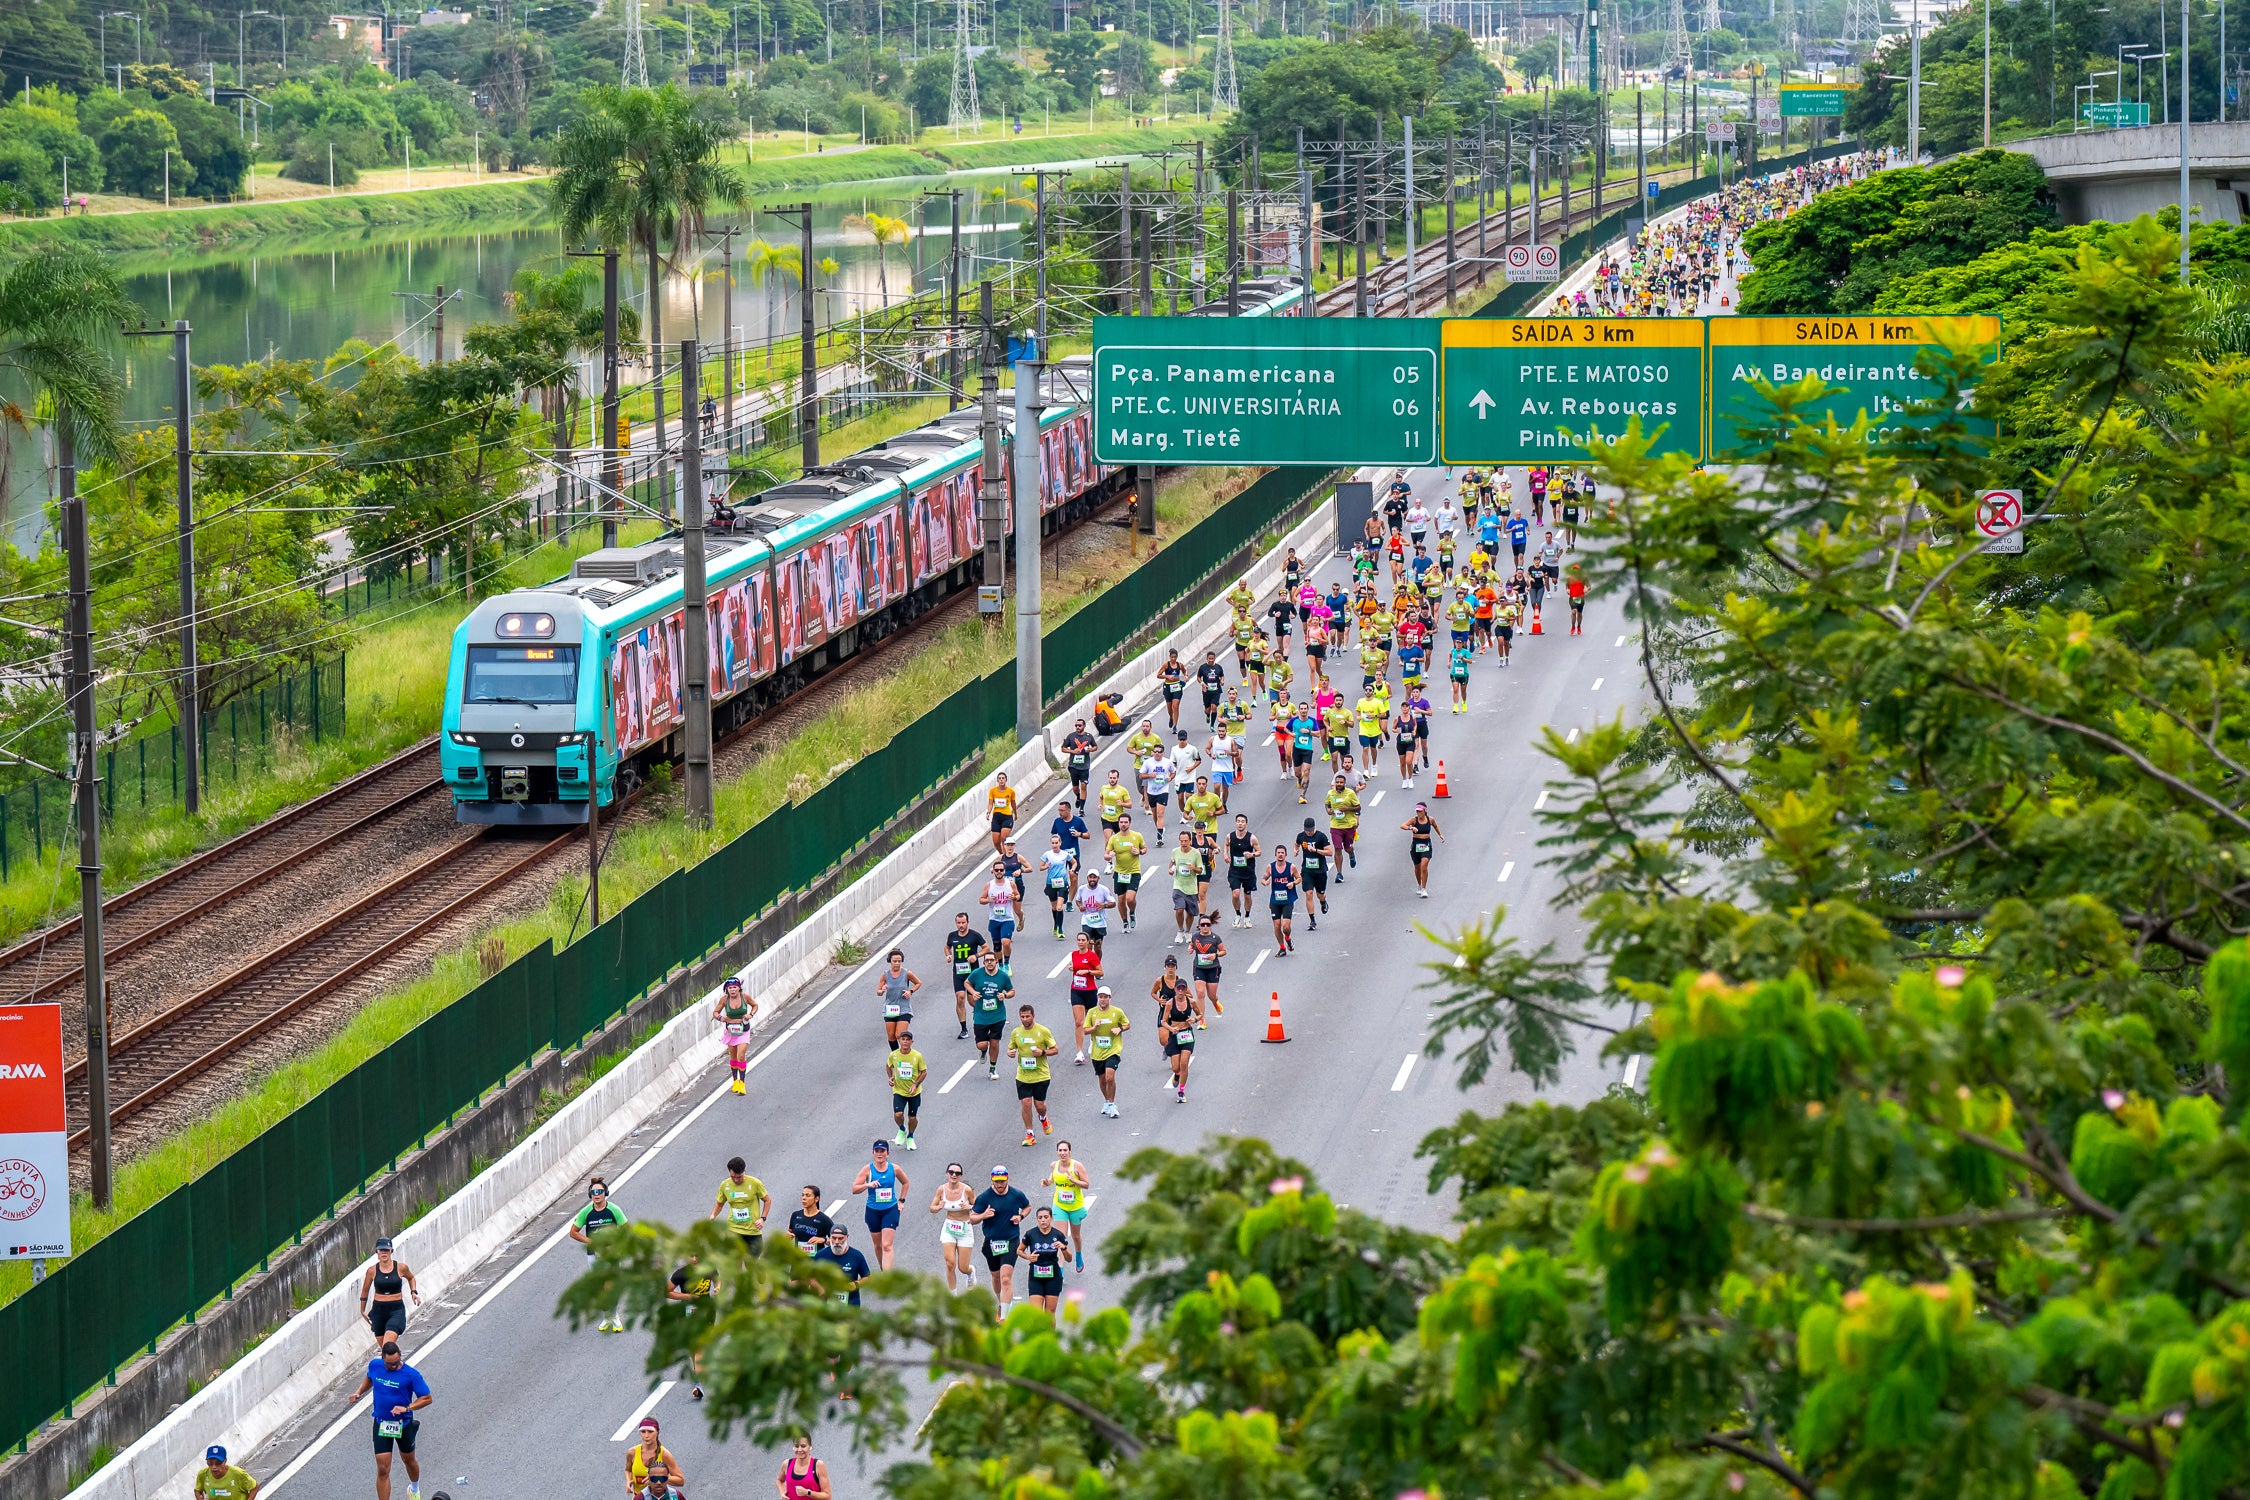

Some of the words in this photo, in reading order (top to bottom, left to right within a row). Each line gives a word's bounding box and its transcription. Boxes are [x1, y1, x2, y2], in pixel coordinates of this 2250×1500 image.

[1513, 252, 1525, 260] 90
[1540, 252, 1552, 260] 60
[1512, 320, 1573, 342] SAÍDA
[1583, 325, 1595, 342] 3
[1603, 325, 1635, 342] km
[1796, 317, 1858, 340] SAÍDA
[1869, 323, 1875, 339] 1
[1883, 323, 1914, 339] km
[1111, 364, 1160, 386] Pça.
[1167, 364, 1336, 384] Panamericana
[1393, 366, 1420, 384] 05
[1586, 365, 1669, 383] MATOSO
[1184, 390, 1342, 416] UNIVERSITÁRIA
[1392, 399, 1419, 417] 06
[1520, 397, 1554, 415] Av.
[1562, 397, 1677, 418] Rebouças
[1111, 429, 1174, 452] Marg.
[1182, 428, 1242, 447] Tietê
[1403, 430, 1420, 448] 11
[0, 1063, 47, 1079] RAVA
[2, 1197, 41, 1219] PINHEIROS
